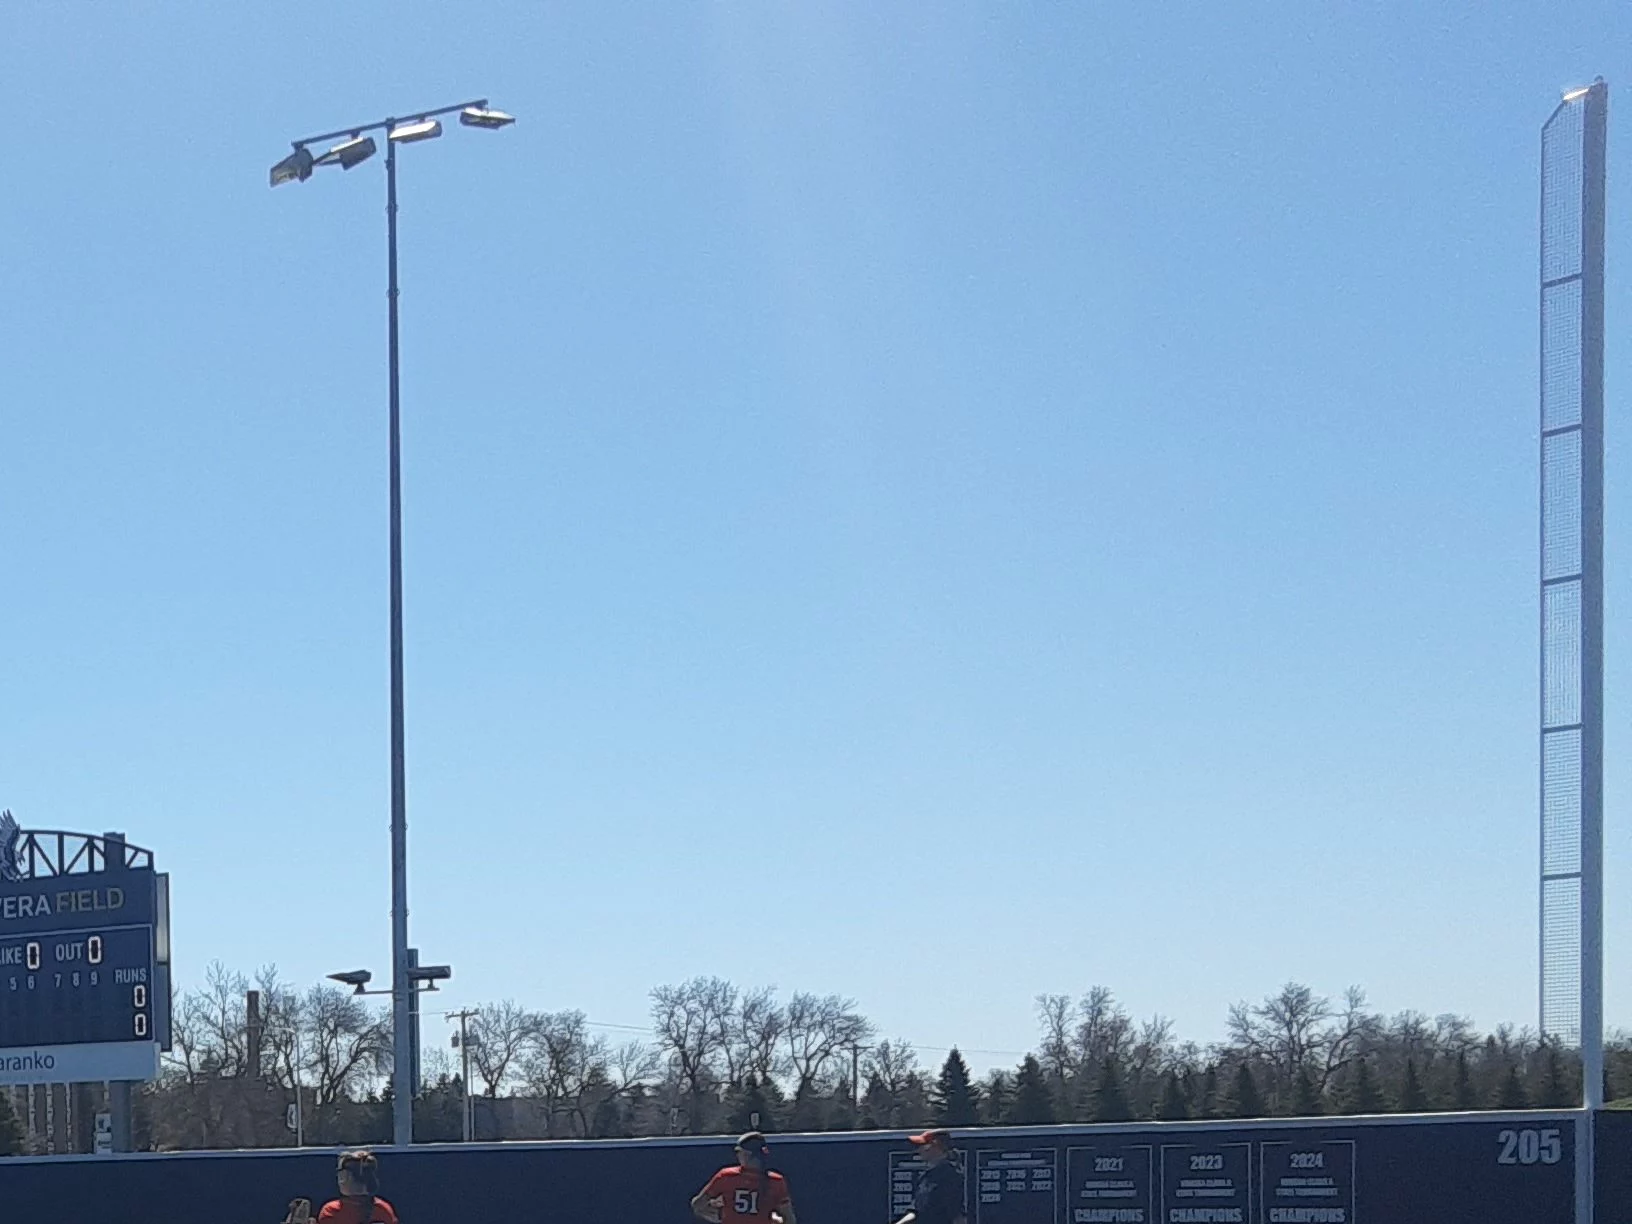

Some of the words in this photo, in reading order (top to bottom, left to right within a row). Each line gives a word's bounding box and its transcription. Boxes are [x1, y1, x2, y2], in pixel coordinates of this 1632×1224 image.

[56, 887, 125, 914] FIELD
[27, 941, 40, 970] 0
[55, 942, 85, 962] OUT
[88, 935, 102, 964] 0
[9, 977, 17, 991] 5
[27, 975, 35, 990] 6
[54, 973, 62, 988] 7
[72, 972, 80, 987] 8
[90, 971, 98, 986] 9
[114, 967, 148, 984] RUNS
[133, 984, 146, 1008] 0
[134, 1013, 147, 1036] 0
[1496, 1128, 1563, 1165] 205
[1094, 1157, 1125, 1172] 2021
[1189, 1154, 1224, 1171] 2023
[1290, 1151, 1325, 1169] 2024
[734, 1188, 759, 1215] 51
